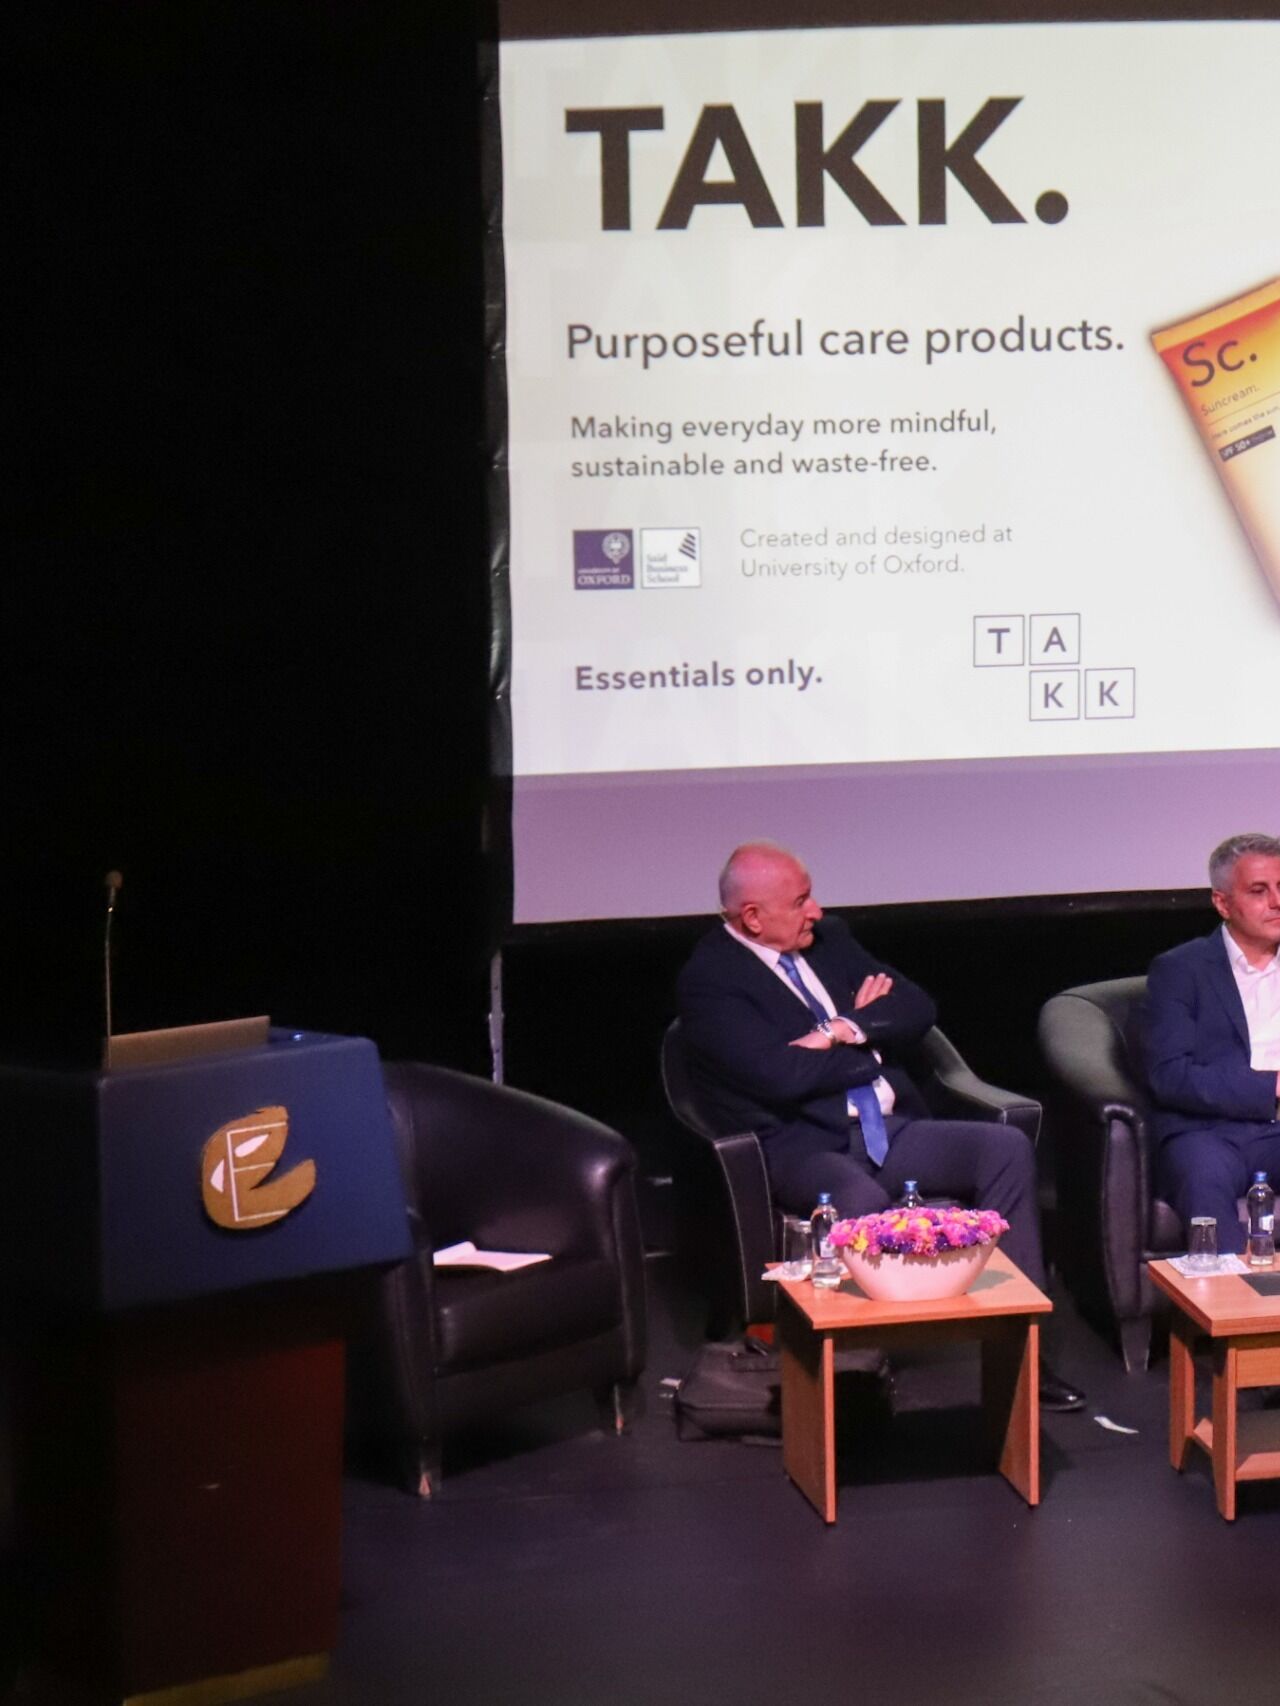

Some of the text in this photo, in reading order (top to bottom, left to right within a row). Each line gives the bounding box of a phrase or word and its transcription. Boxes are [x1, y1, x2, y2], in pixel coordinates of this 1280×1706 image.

[565, 97, 1068, 231] TAKK.
[566, 314, 1124, 370] Purposeful care products.
[1183, 340, 1257, 388] Sc.
[571, 409, 997, 444] Making everyday more mindful,
[571, 449, 937, 478] sustainable and waste-free.
[740, 523, 1012, 549] Created and designed at
[577, 575, 631, 585] OXFORD
[741, 553, 964, 581] University of Oxford.
[987, 627, 1066, 654] T A
[575, 659, 822, 691] Essentials only.
[1044, 681, 1119, 708] K K
